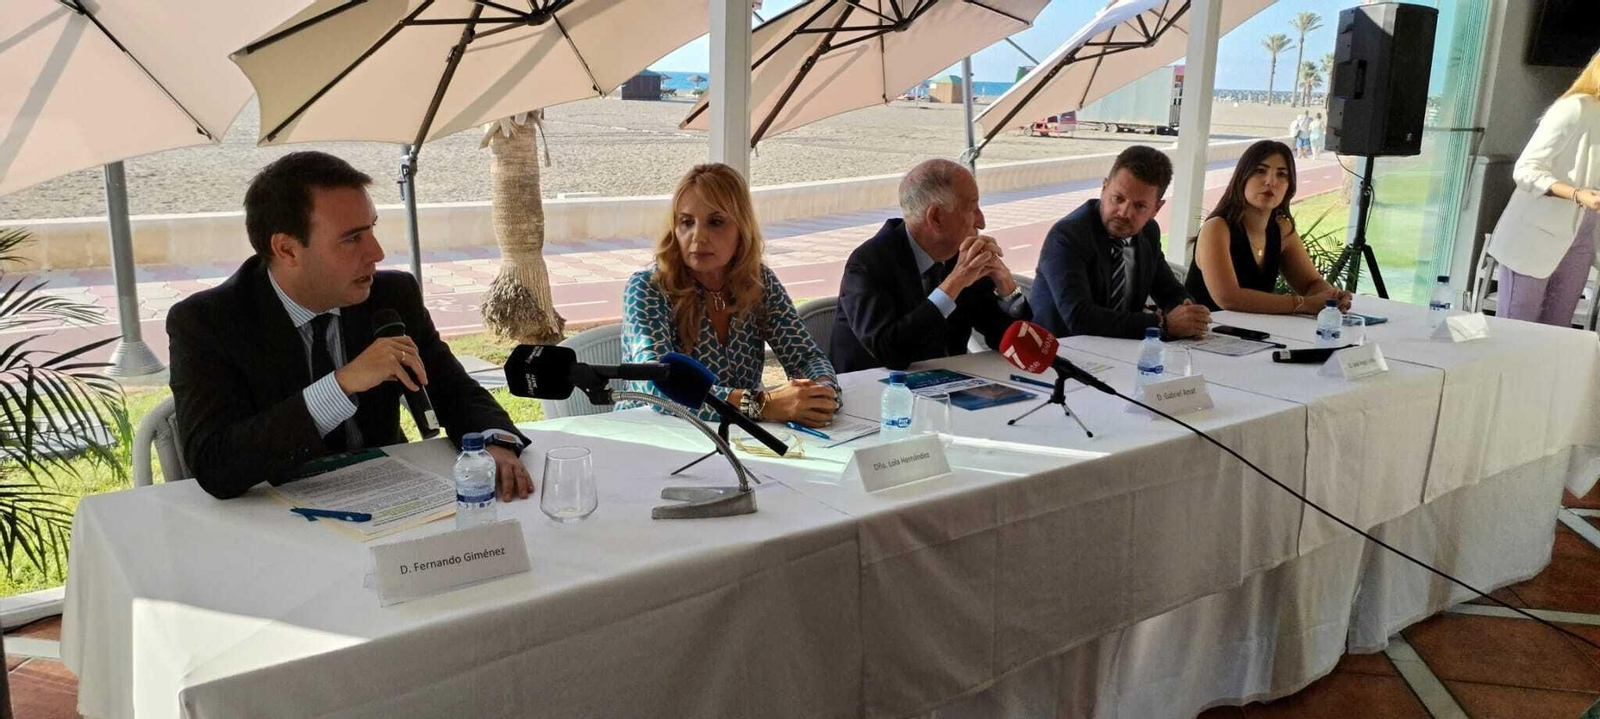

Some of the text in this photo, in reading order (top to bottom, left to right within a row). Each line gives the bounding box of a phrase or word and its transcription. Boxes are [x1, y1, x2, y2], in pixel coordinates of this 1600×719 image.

[888, 459, 901, 468] Lola
[900, 452, 930, 464] Hernández
[400, 547, 506, 575] D. Fernando Giménez
